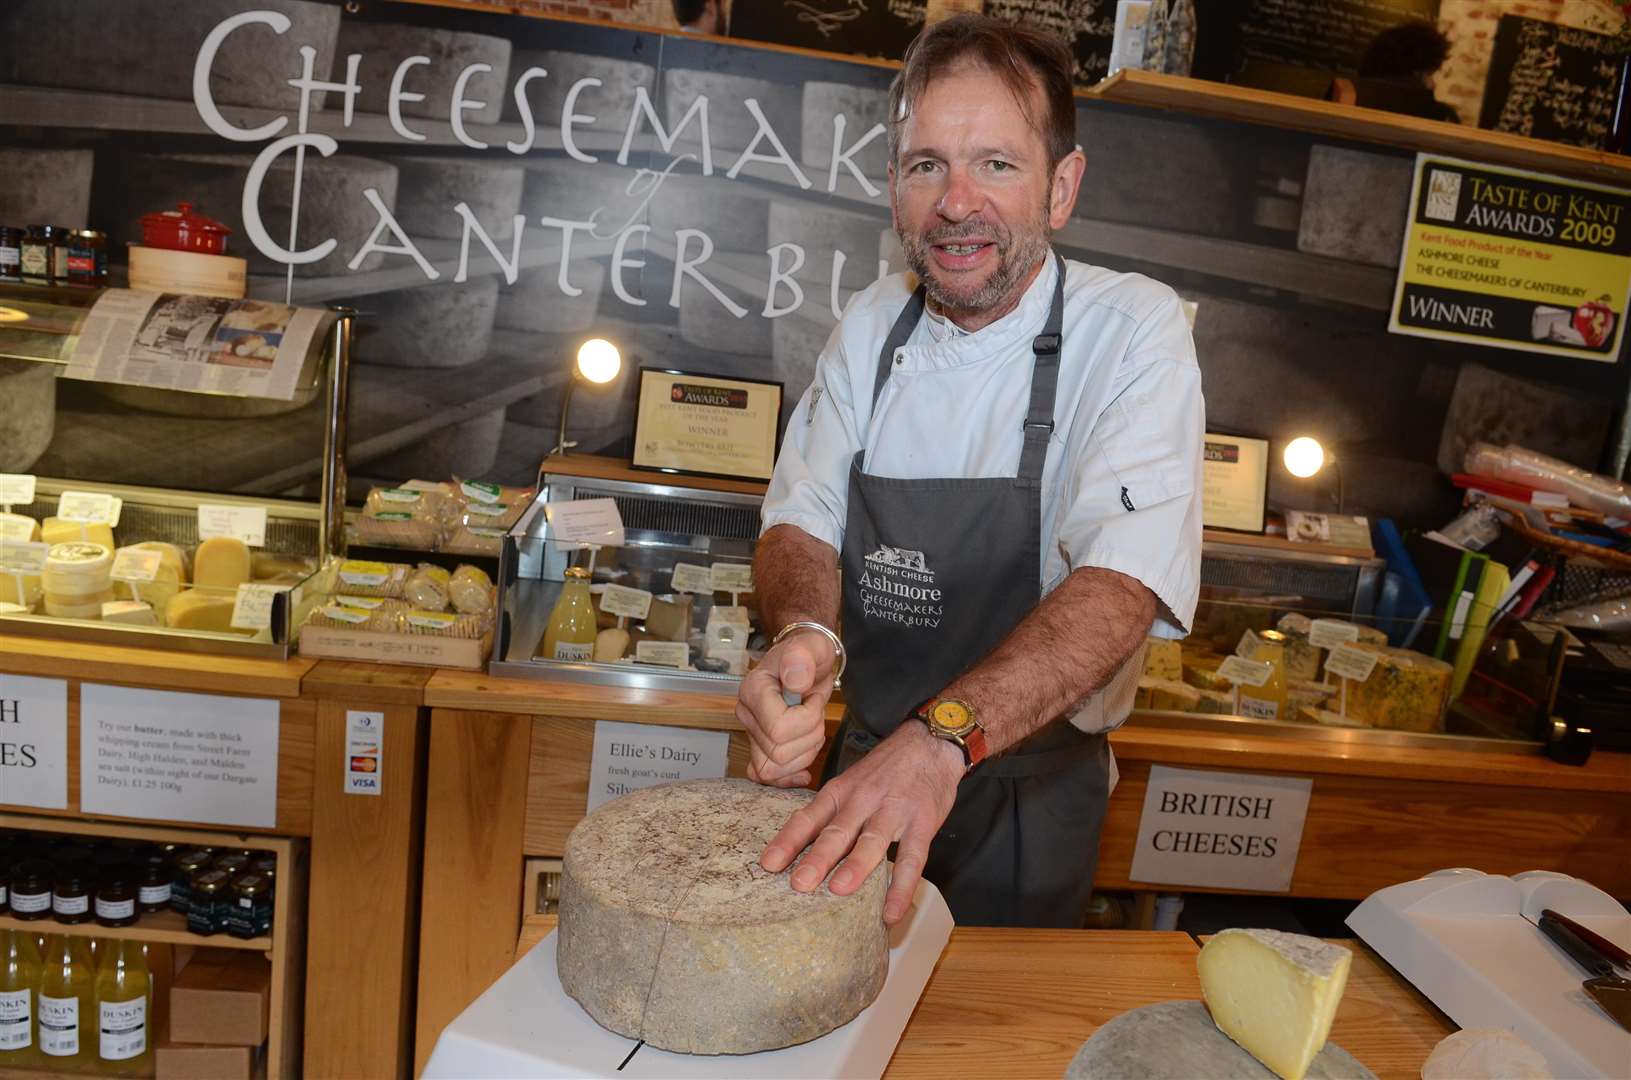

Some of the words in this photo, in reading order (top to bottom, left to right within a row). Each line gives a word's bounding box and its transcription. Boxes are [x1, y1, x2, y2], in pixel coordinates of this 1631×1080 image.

[588, 153, 696, 241] of
[1469, 177, 1528, 209] TASTE
[1533, 190, 1562, 210] OF
[1567, 195, 1624, 225] KENT
[1465, 204, 1555, 238] AWARDS
[1560, 218, 1616, 246] 2009
[1418, 248, 1463, 265] ASHMORE
[1466, 253, 1500, 269] CHEESE
[1420, 232, 1443, 244] Kent
[1468, 239, 1503, 254] Product
[1504, 244, 1516, 255] of
[1517, 247, 1532, 259] the
[1533, 250, 1553, 261] Year
[1416, 263, 1433, 276] THE
[1435, 266, 1507, 287] CHEESEMAKERS
[1509, 277, 1521, 289] OF
[1523, 280, 1587, 297] CANTERBURY
[1408, 294, 1495, 329] WINNER
[684, 392, 730, 406] AWARDS
[865, 561, 898, 575] KENTISH
[901, 570, 934, 584] CHEESE
[858, 570, 942, 601] Ashmore
[860, 589, 943, 615] CHEESEMAKERS
[863, 600, 941, 628] CANTERBURY
[98, 720, 113, 732] Try
[116, 723, 132, 732] our
[169, 728, 194, 738] made
[197, 730, 217, 740] with
[219, 731, 242, 742] thick
[98, 735, 140, 749] whipping
[142, 740, 171, 750] cream
[172, 741, 195, 751] from
[128, 750, 151, 763] High
[191, 757, 208, 767] and
[609, 742, 657, 760] Ellie's
[661, 746, 702, 766] Dairy
[98, 764, 113, 772] sea
[114, 763, 131, 773] salt
[132, 765, 165, 776] (within
[167, 768, 190, 779] sight
[191, 770, 203, 779] of
[203, 773, 219, 781] our
[352, 778, 377, 788] VISA
[608, 765, 630, 777] fresh
[632, 767, 659, 778] goat's
[660, 770, 681, 780] curd
[160, 781, 183, 793] 100g
[1159, 791, 1274, 820] BRITISH
[1151, 829, 1279, 859] CHEESES
